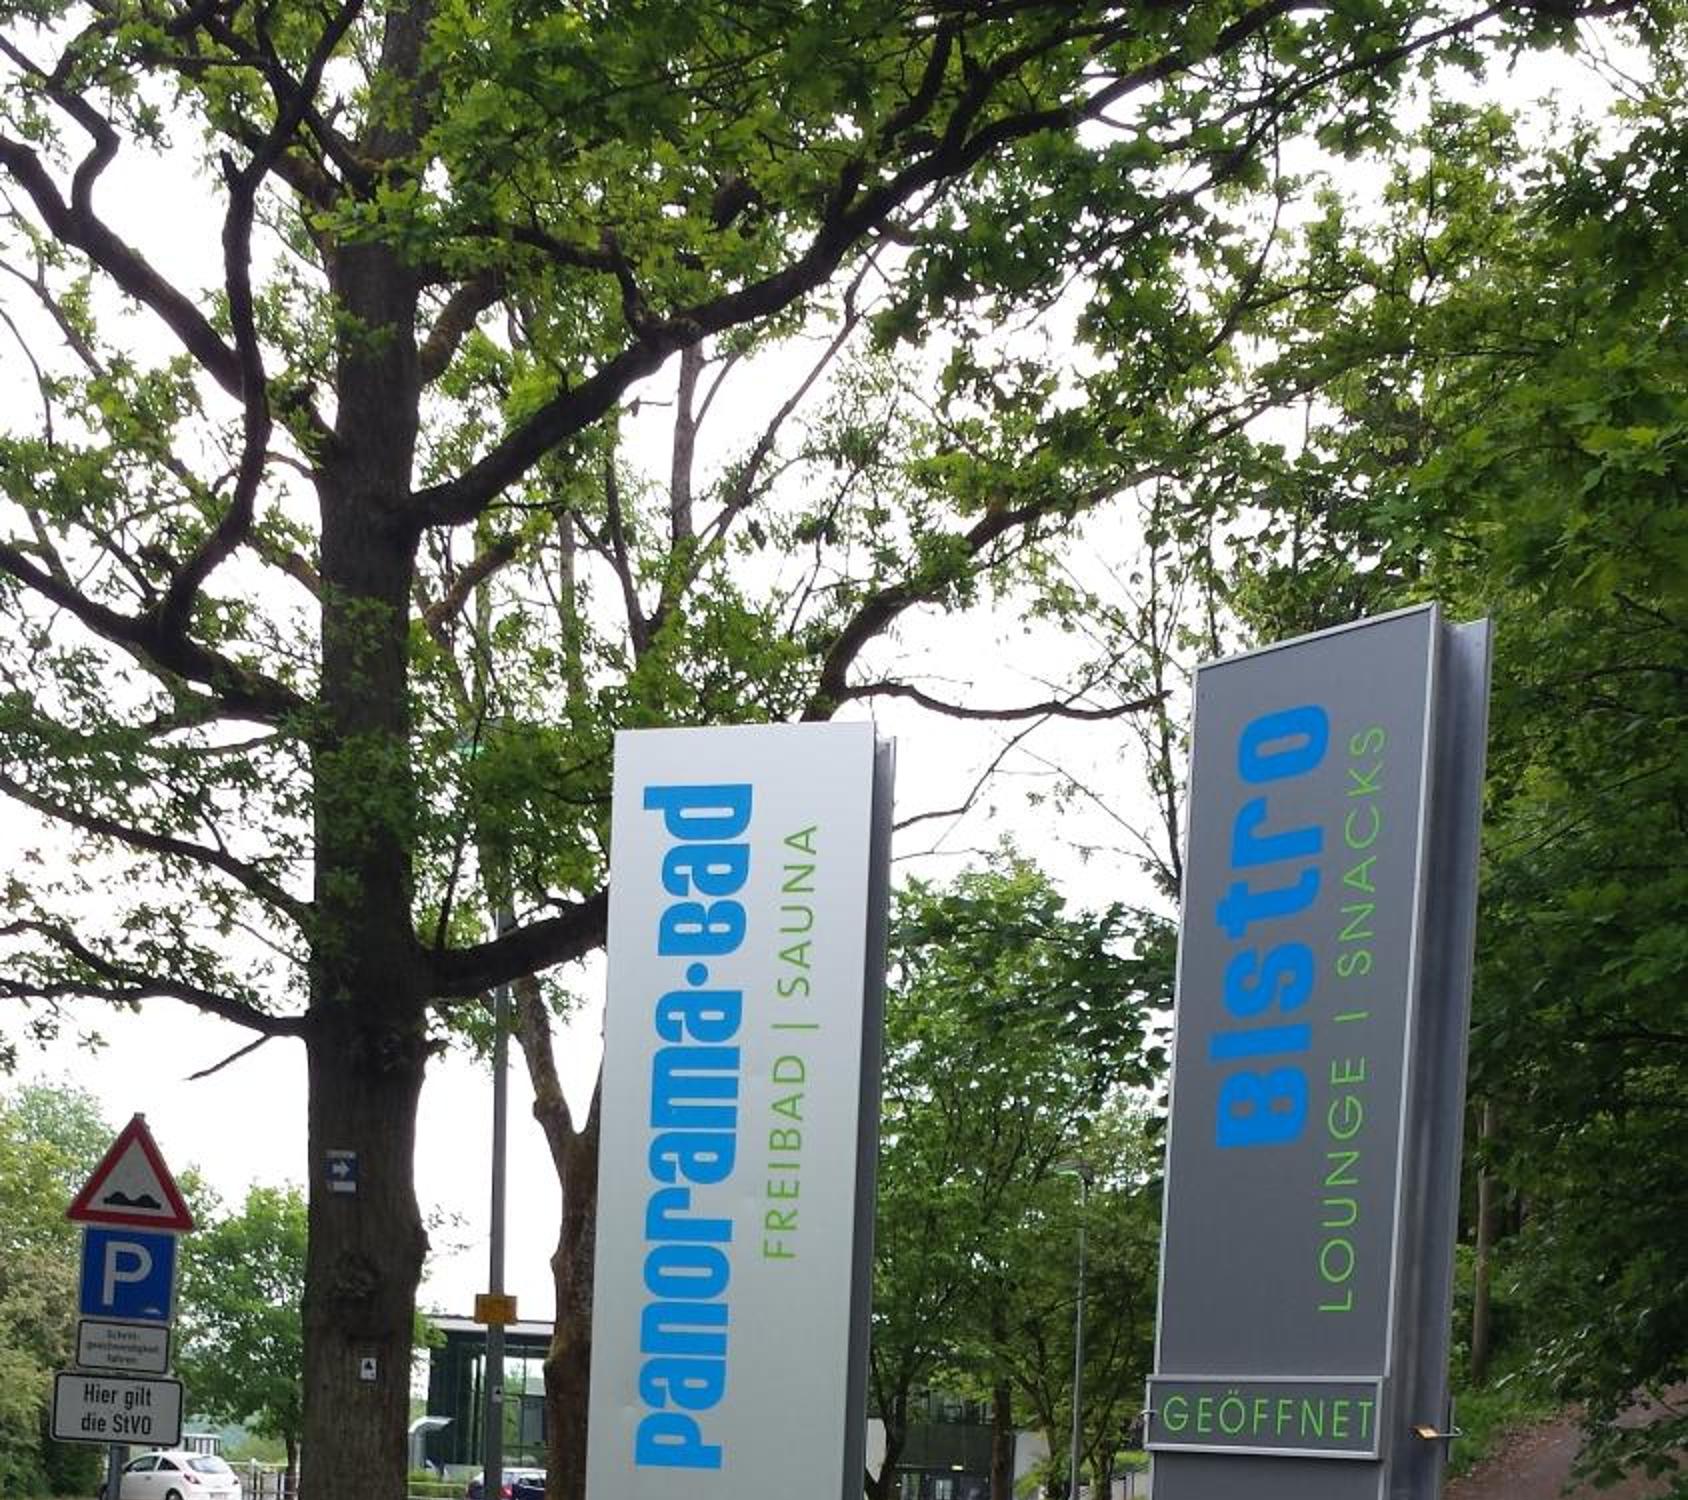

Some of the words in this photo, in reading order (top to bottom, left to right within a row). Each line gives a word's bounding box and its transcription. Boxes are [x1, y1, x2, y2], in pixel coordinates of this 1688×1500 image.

[777, 825, 819, 998] SAUNA
[1335, 725, 1387, 979] SNACKS
[761, 1054, 807, 1262] FREIBAD
[1317, 1056, 1368, 1314] LOUNGE
[102, 1241, 153, 1306] P
[81, 1412, 107, 1433] die
[112, 1413, 152, 1435] StVO
[84, 1383, 117, 1405] Hier
[124, 1386, 152, 1411] gilt
[1162, 1387, 1375, 1441] GEÖFFNET
